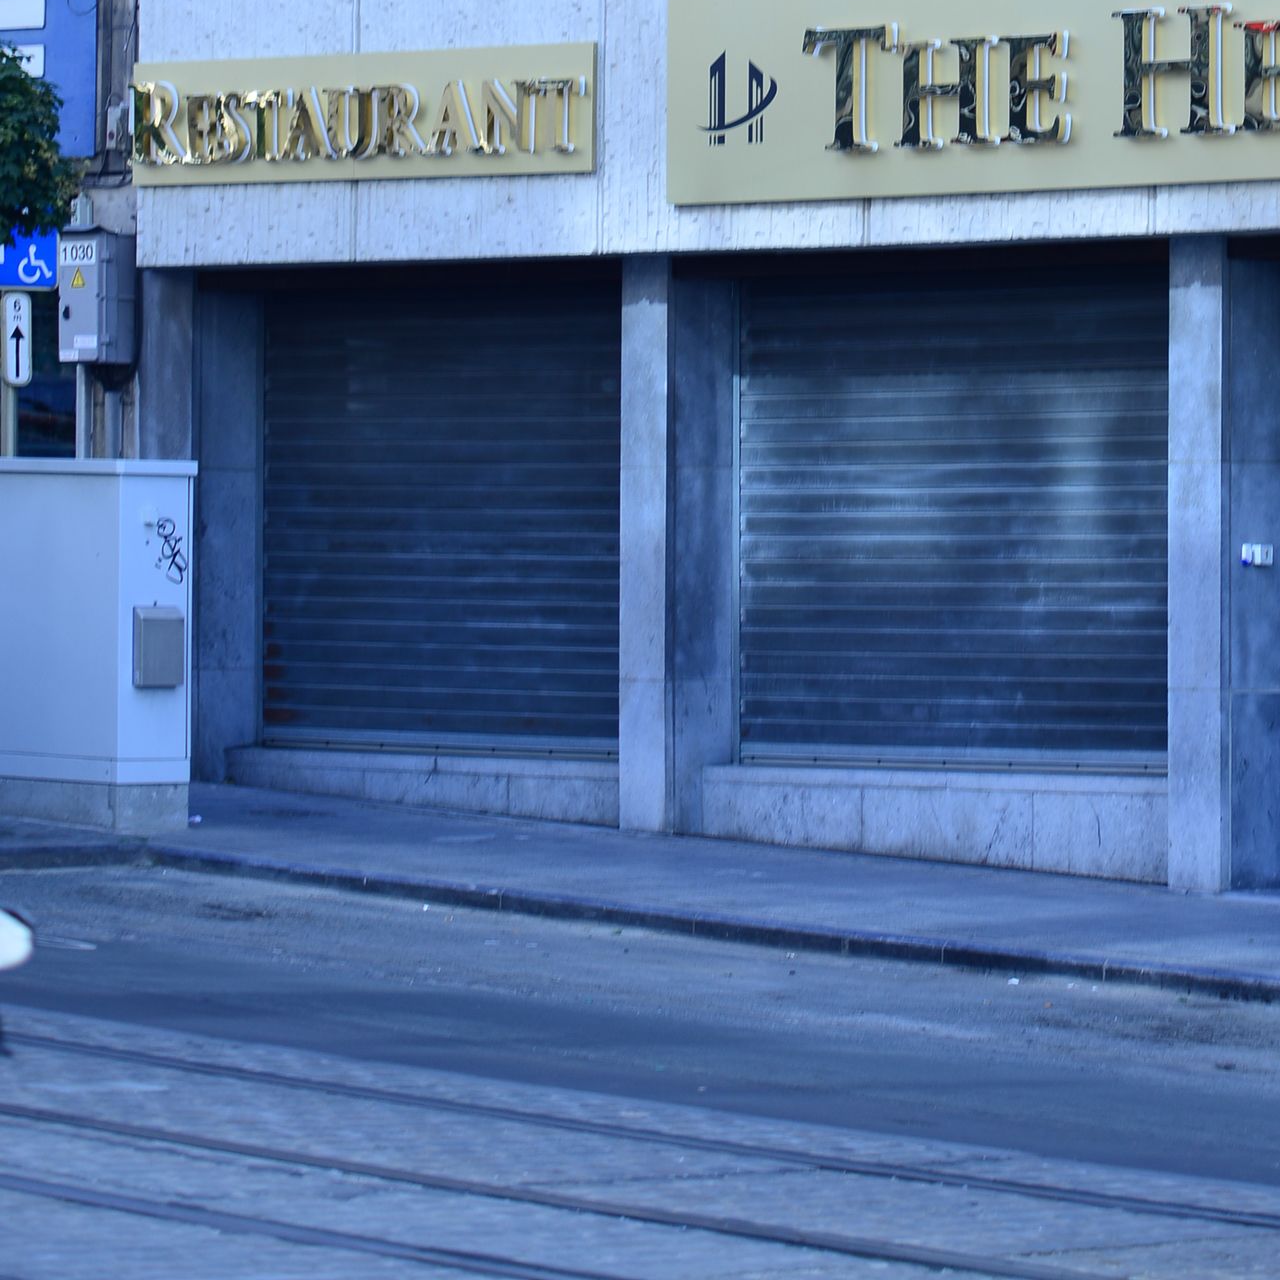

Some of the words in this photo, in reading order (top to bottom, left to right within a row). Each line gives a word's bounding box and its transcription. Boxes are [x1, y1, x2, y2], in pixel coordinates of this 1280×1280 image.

[802, 22, 1072, 153] THE
[128, 75, 586, 166] RESTAURANT
[61, 244, 94, 261] 1030
[13, 298, 22, 313] 6
